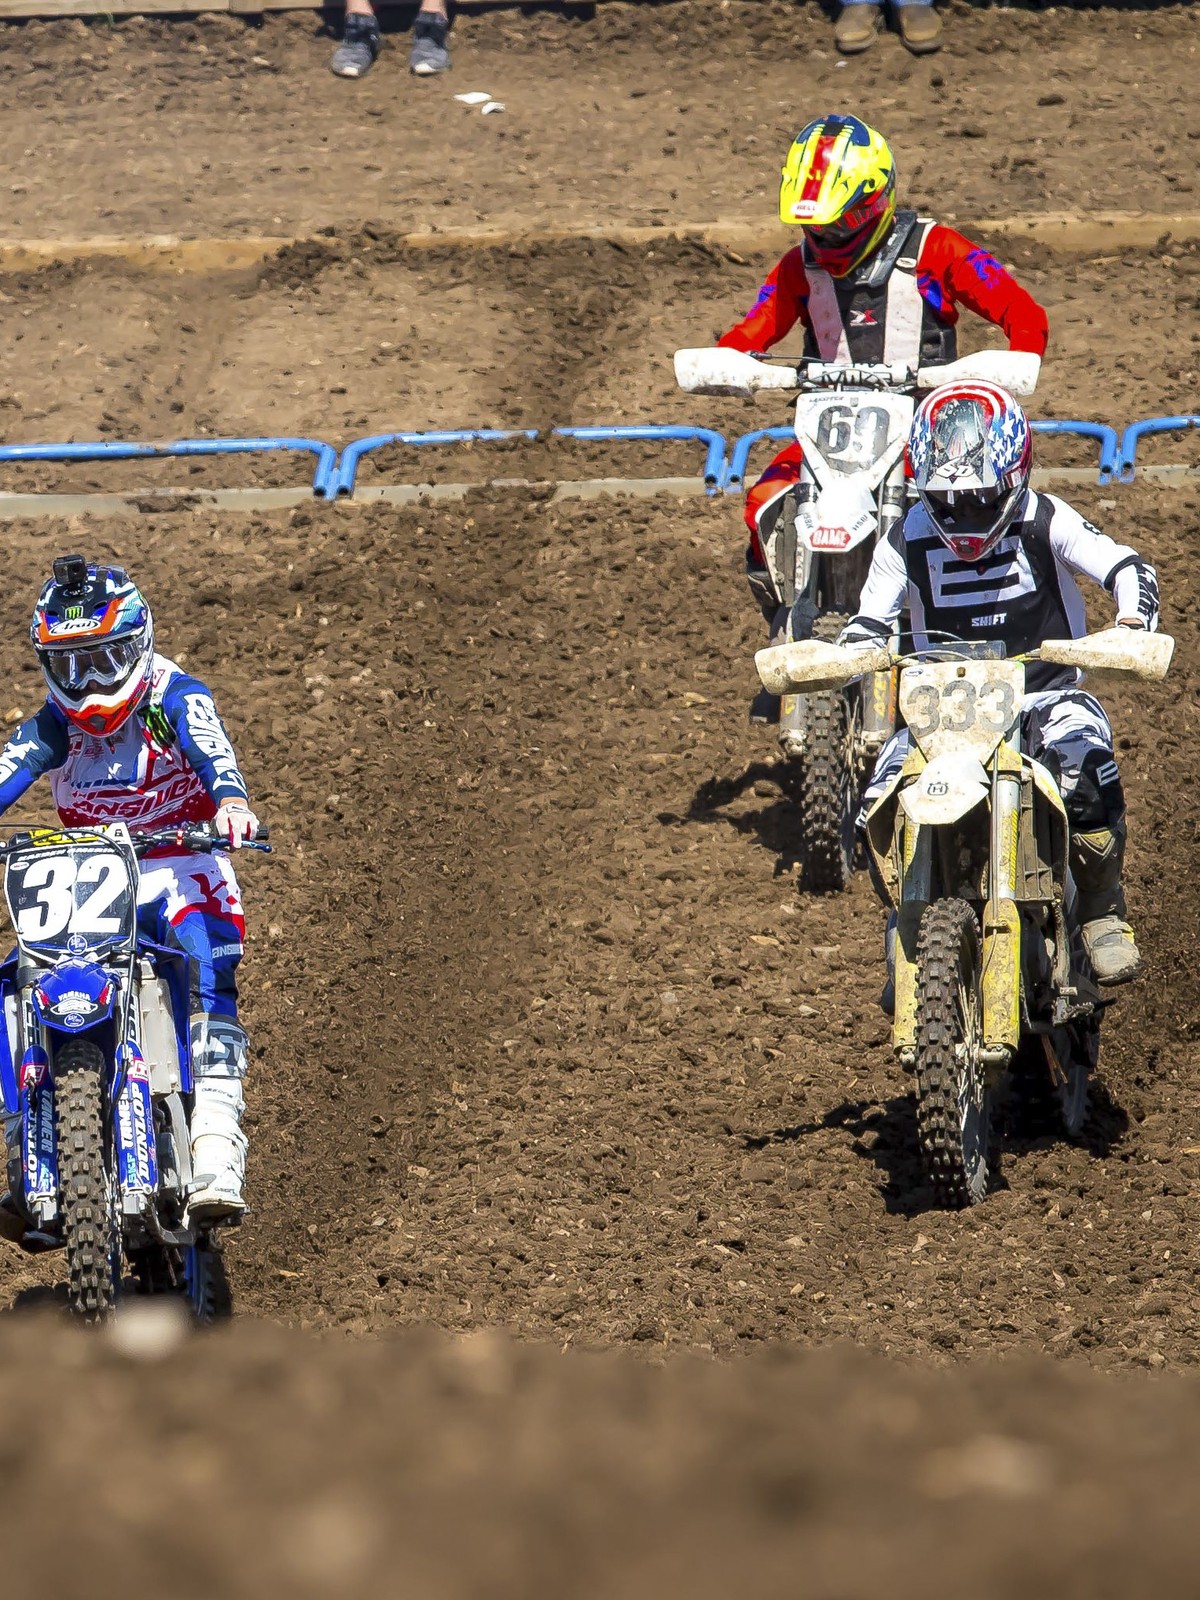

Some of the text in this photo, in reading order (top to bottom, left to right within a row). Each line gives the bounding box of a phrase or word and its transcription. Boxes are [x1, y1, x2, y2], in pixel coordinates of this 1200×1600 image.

[971, 612, 1008, 628] SHIFT
[906, 679, 1015, 738] 333
[17, 853, 130, 942] 32
[58, 991, 91, 1001] YAMAHA
[131, 1082, 149, 1181] DUNLOP
